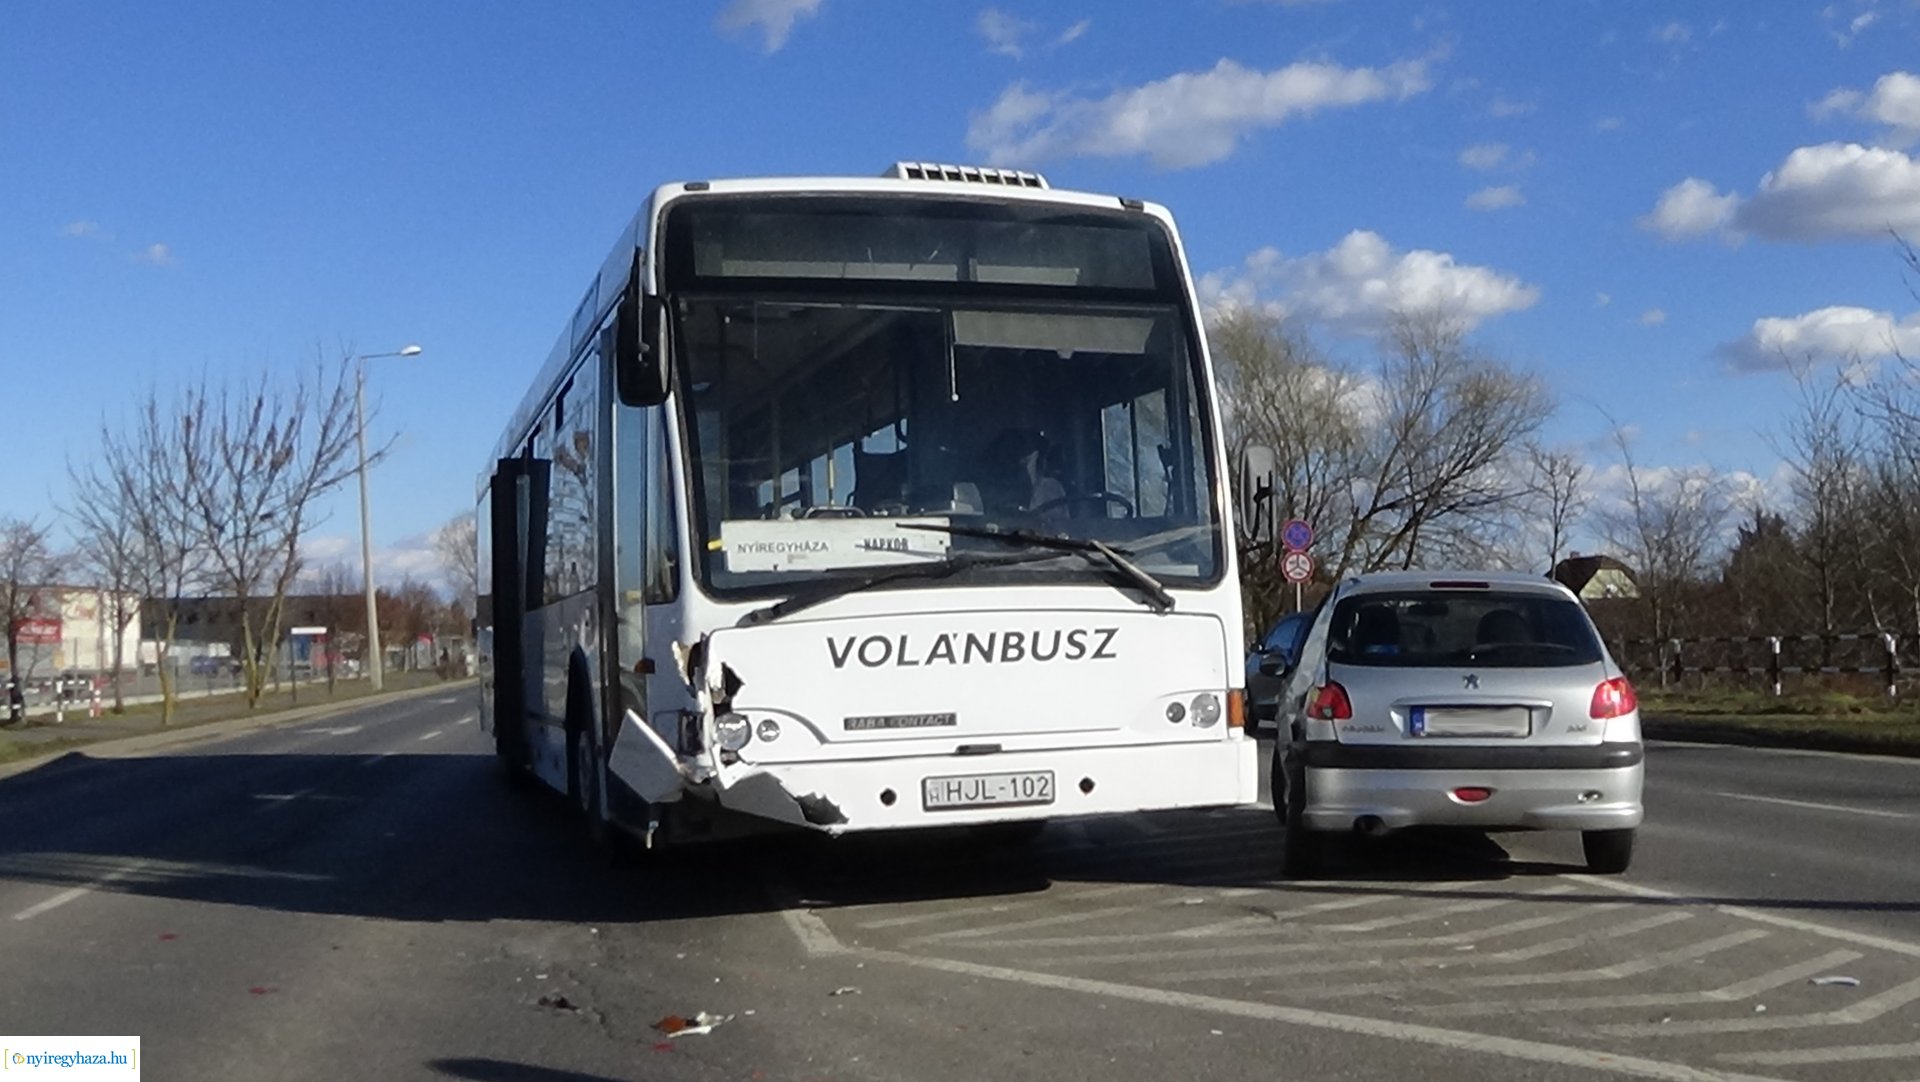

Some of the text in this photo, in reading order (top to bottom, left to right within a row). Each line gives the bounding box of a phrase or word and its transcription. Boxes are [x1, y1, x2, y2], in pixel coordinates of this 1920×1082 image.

[737, 540, 829, 553] NYÍREGYHÁZA
[826, 627, 1120, 669] VOLÁNBUSZ
[946, 775, 1050, 801] HJL-102
